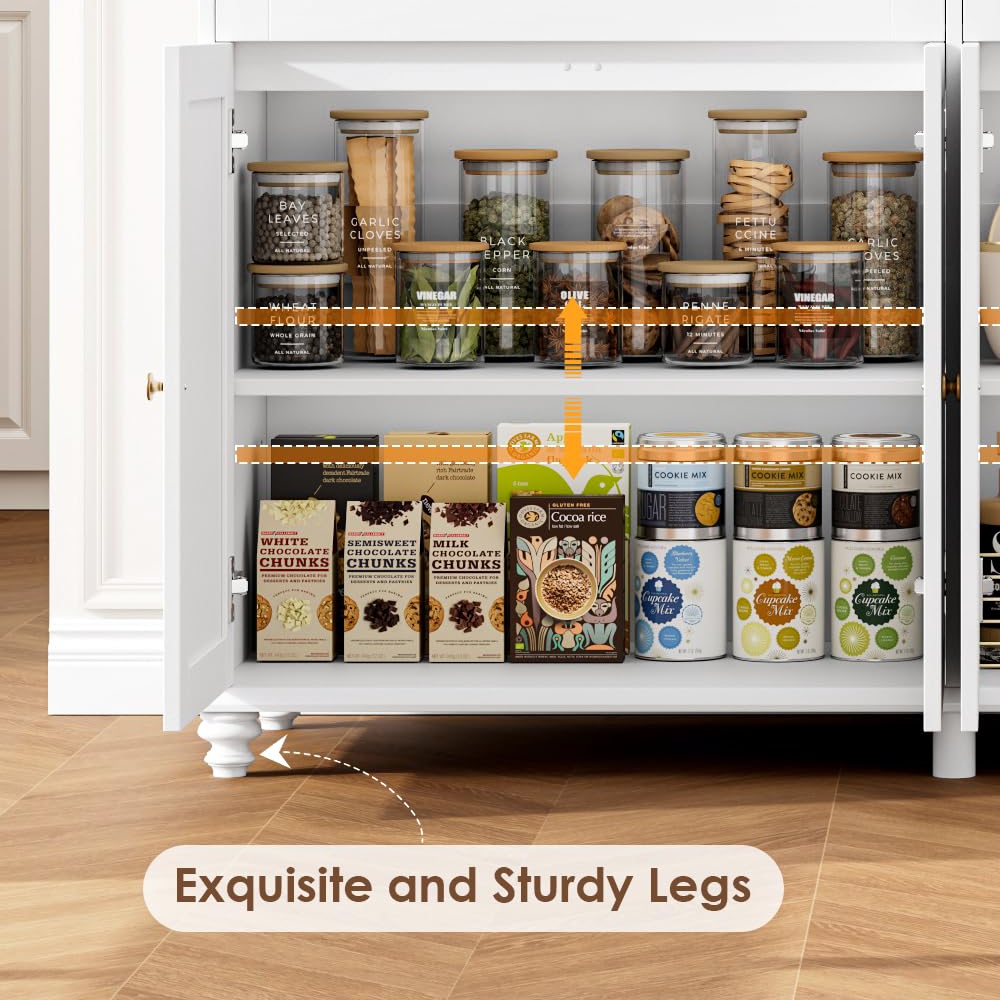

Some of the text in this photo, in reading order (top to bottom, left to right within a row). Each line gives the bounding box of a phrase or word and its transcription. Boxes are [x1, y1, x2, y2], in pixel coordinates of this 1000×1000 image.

[279, 200, 306, 211] BAY
[268, 213, 319, 224] LEAVES
[350, 217, 400, 227] GARLIC
[735, 217, 777, 227] FETTU
[350, 230, 401, 240] CLOVES
[735, 230, 777, 240] CCINE
[480, 236, 526, 246] BLACK
[484, 249, 530, 260] EPPER
[864, 251, 900, 261] OVES
[416, 290, 457, 301] VINEGAR
[560, 290, 590, 300] OLIVE
[793, 292, 835, 303] VINEGAR
[268, 302, 317, 312] WHEAT
[682, 301, 729, 311] PENNE
[270, 315, 316, 325] FLOUR
[681, 315, 730, 324] RIGATE
[654, 471, 707, 479] COOKIE MIX
[751, 471, 805, 480] COOKIE MIX
[850, 472, 903, 480] COOKIE MIX
[638, 492, 667, 521] UGAR
[551, 511, 607, 522] Cocoa rice
[260, 537, 309, 546] WHITE
[347, 539, 417, 547] SEMISWEET
[432, 540, 470, 548] MILK
[259, 557, 329, 568] CHUNKS
[346, 558, 417, 568] CHUNKS
[431, 559, 501, 570] CHUNKS
[642, 591, 680, 606] Cupcake
[755, 592, 798, 607] Cupcake
[854, 592, 897, 607] Cupcake
[651, 602, 676, 615] Mix
[768, 603, 793, 617] Mix
[866, 603, 893, 617] Mix
